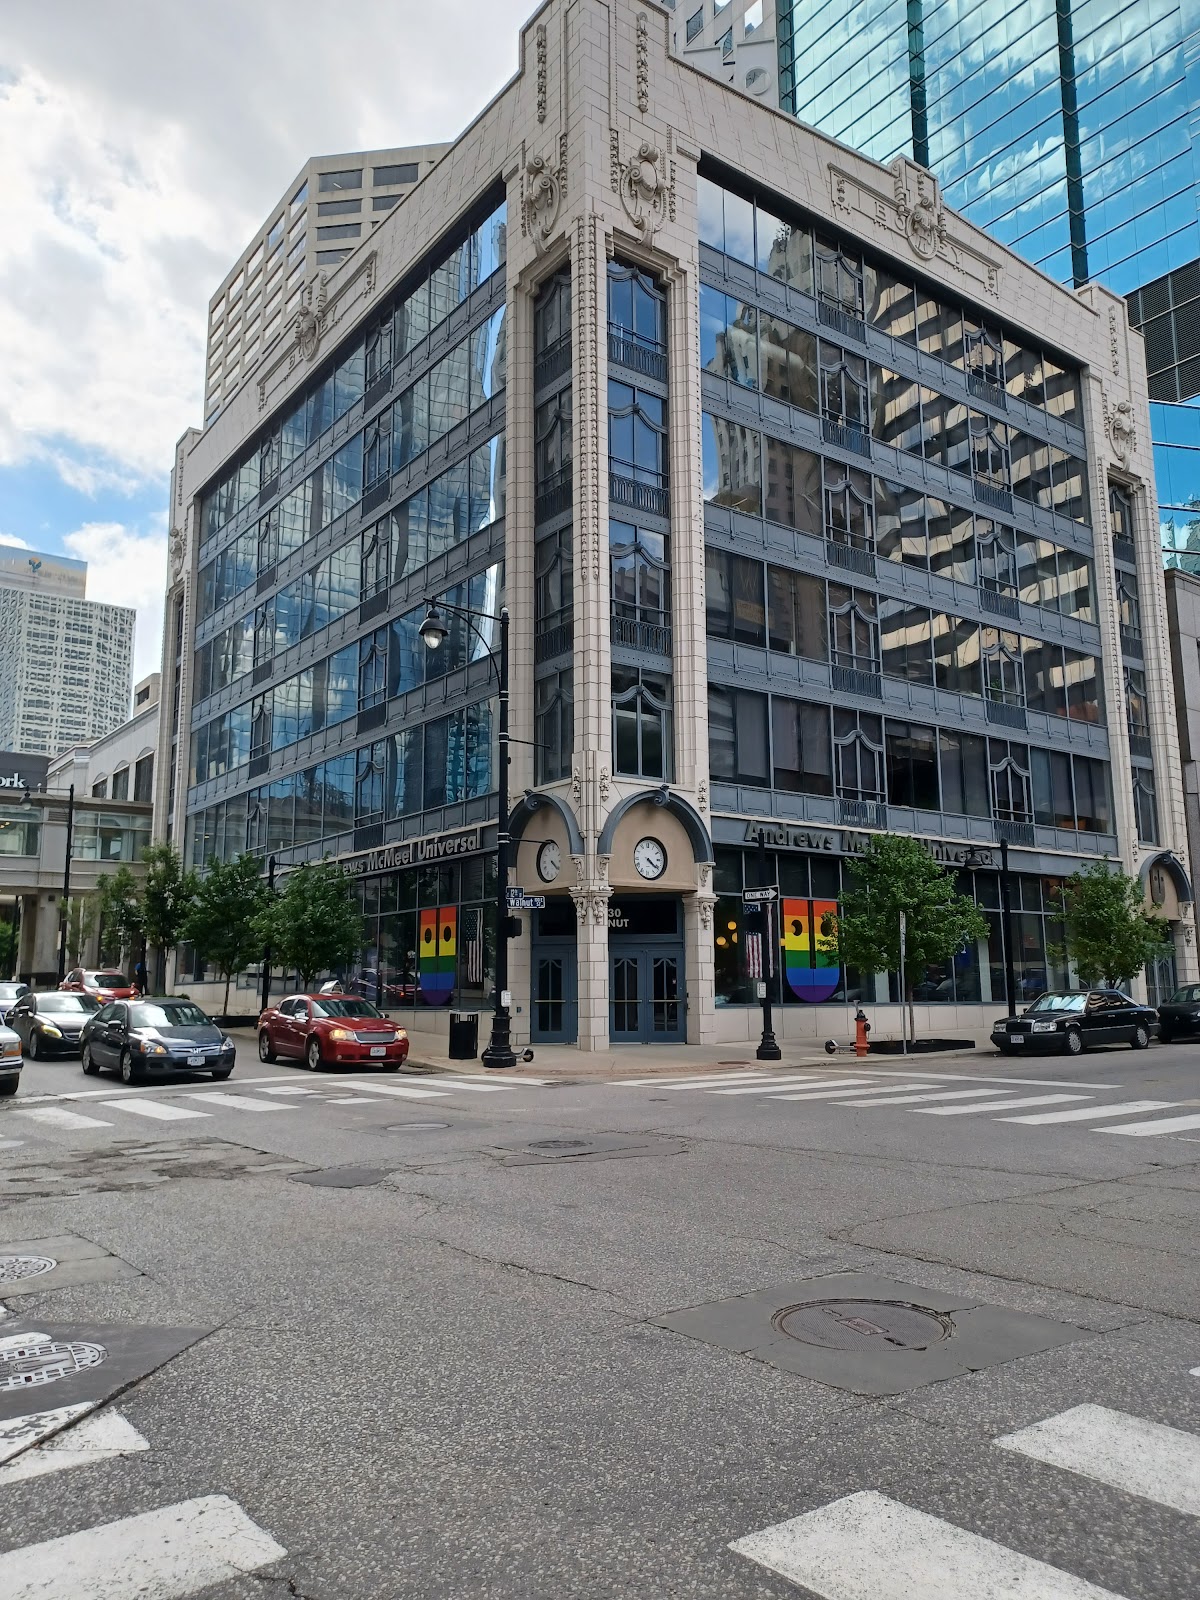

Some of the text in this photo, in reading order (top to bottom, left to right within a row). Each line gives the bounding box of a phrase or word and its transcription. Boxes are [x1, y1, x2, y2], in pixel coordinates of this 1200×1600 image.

[744, 820, 834, 850] Andrews
[367, 843, 414, 872] McMeel
[417, 834, 481, 860] Universal
[509, 898, 534, 907] Walnut
[608, 908, 621, 918] 30
[608, 918, 630, 928] NUT
